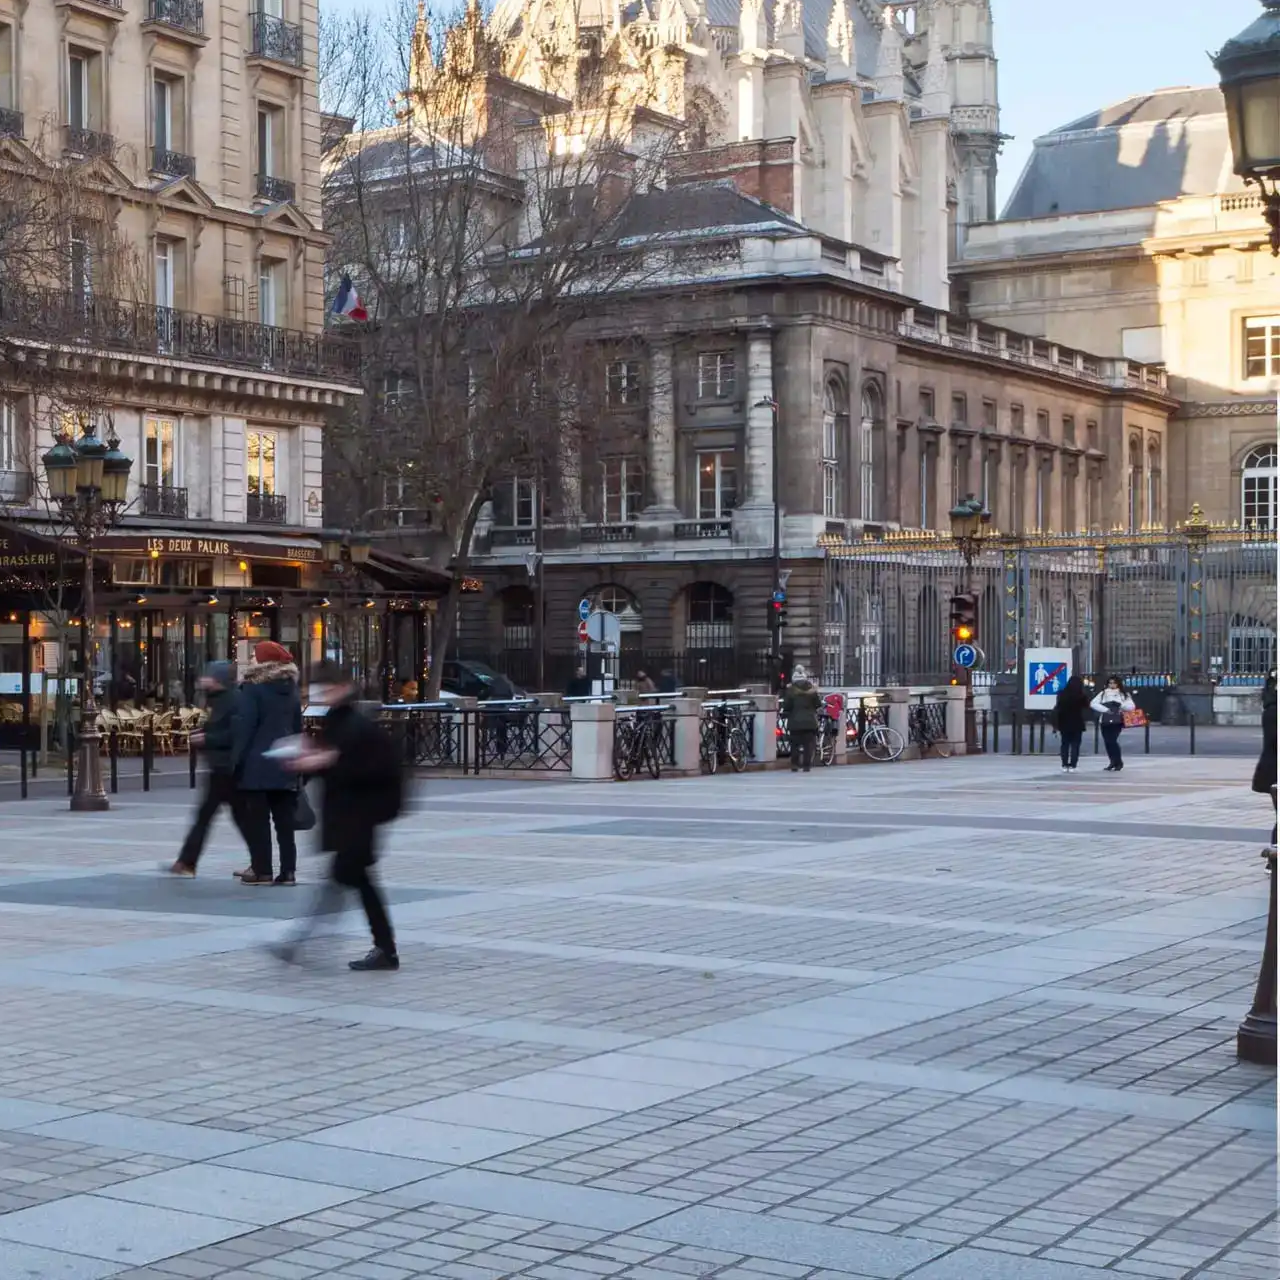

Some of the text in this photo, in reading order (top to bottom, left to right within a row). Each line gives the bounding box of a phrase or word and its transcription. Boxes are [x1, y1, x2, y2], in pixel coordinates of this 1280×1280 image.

[147, 538, 230, 554] LES DEUX PALAIS
[287, 547, 317, 560] BRASSERIE
